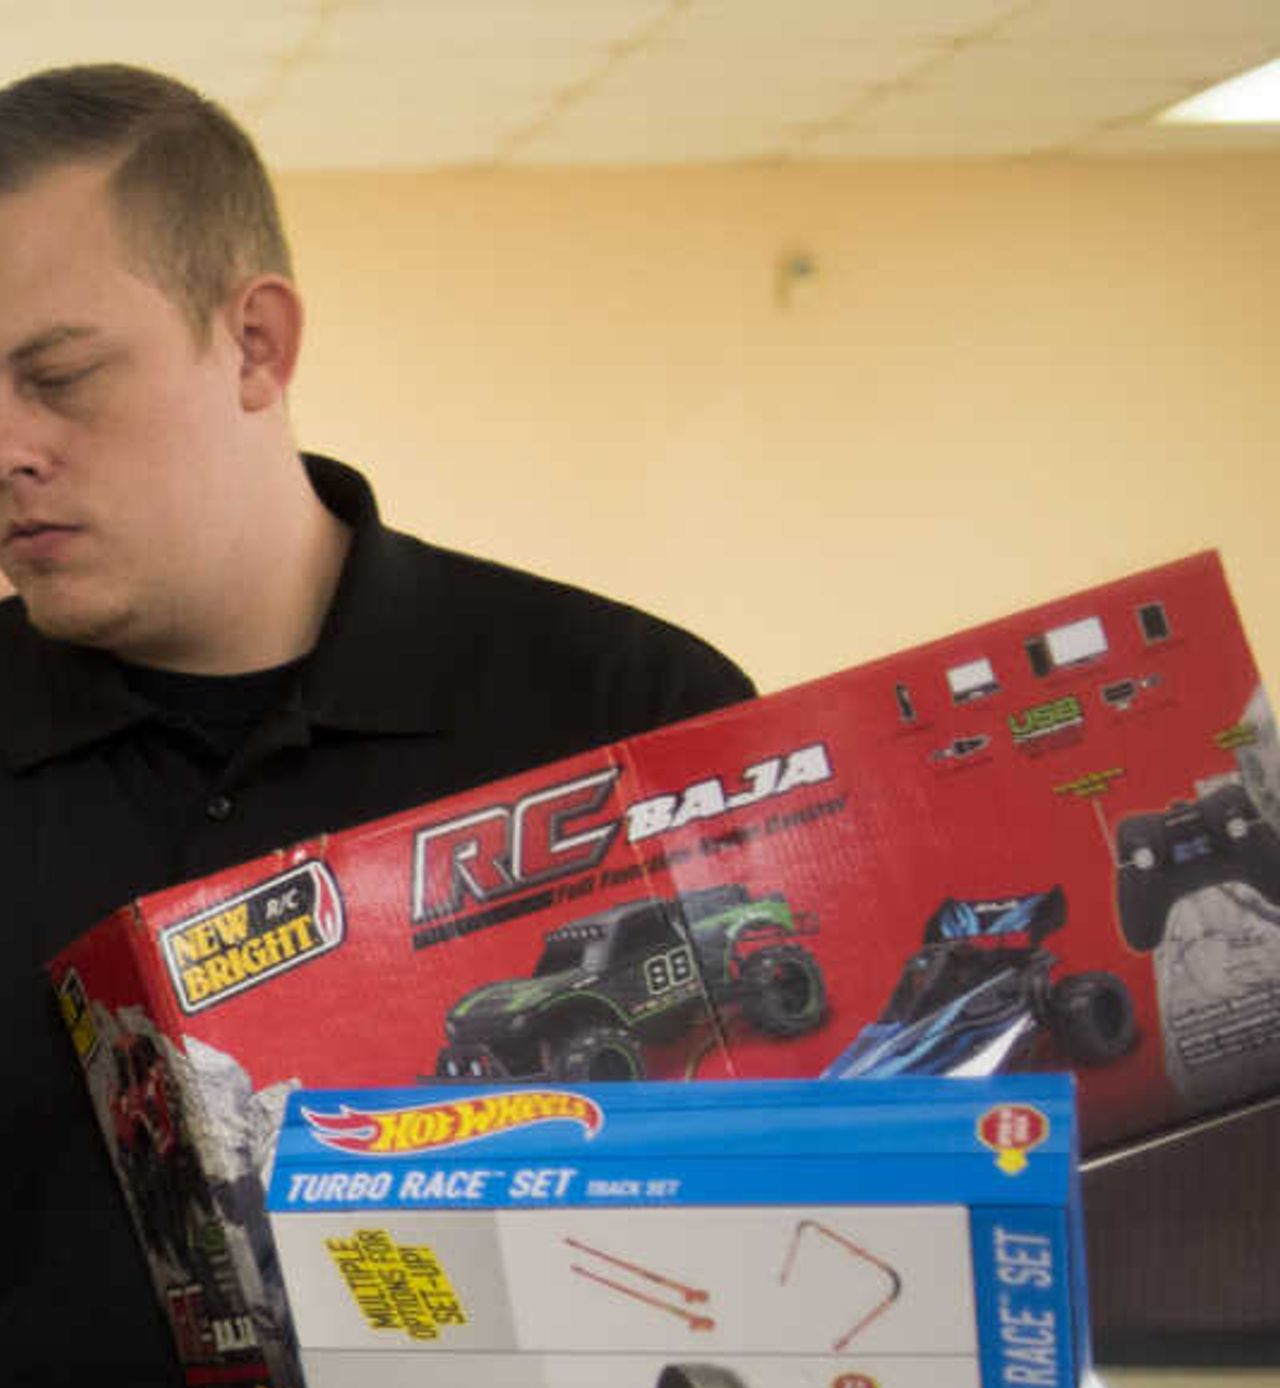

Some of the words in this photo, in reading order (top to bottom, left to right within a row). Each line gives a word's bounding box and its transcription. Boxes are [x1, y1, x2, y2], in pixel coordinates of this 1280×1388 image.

[1007, 697, 1085, 738] USB
[409, 765, 621, 926] RC
[626, 744, 833, 843] BAJA
[172, 902, 249, 968] NEW
[182, 914, 314, 1002] BRIGHT
[368, 1111, 453, 1151] HOT
[453, 1091, 588, 1138] WHEELS
[287, 1172, 391, 1202] TURBO
[508, 1167, 577, 1199] SET
[991, 1226, 1052, 1289] SET
